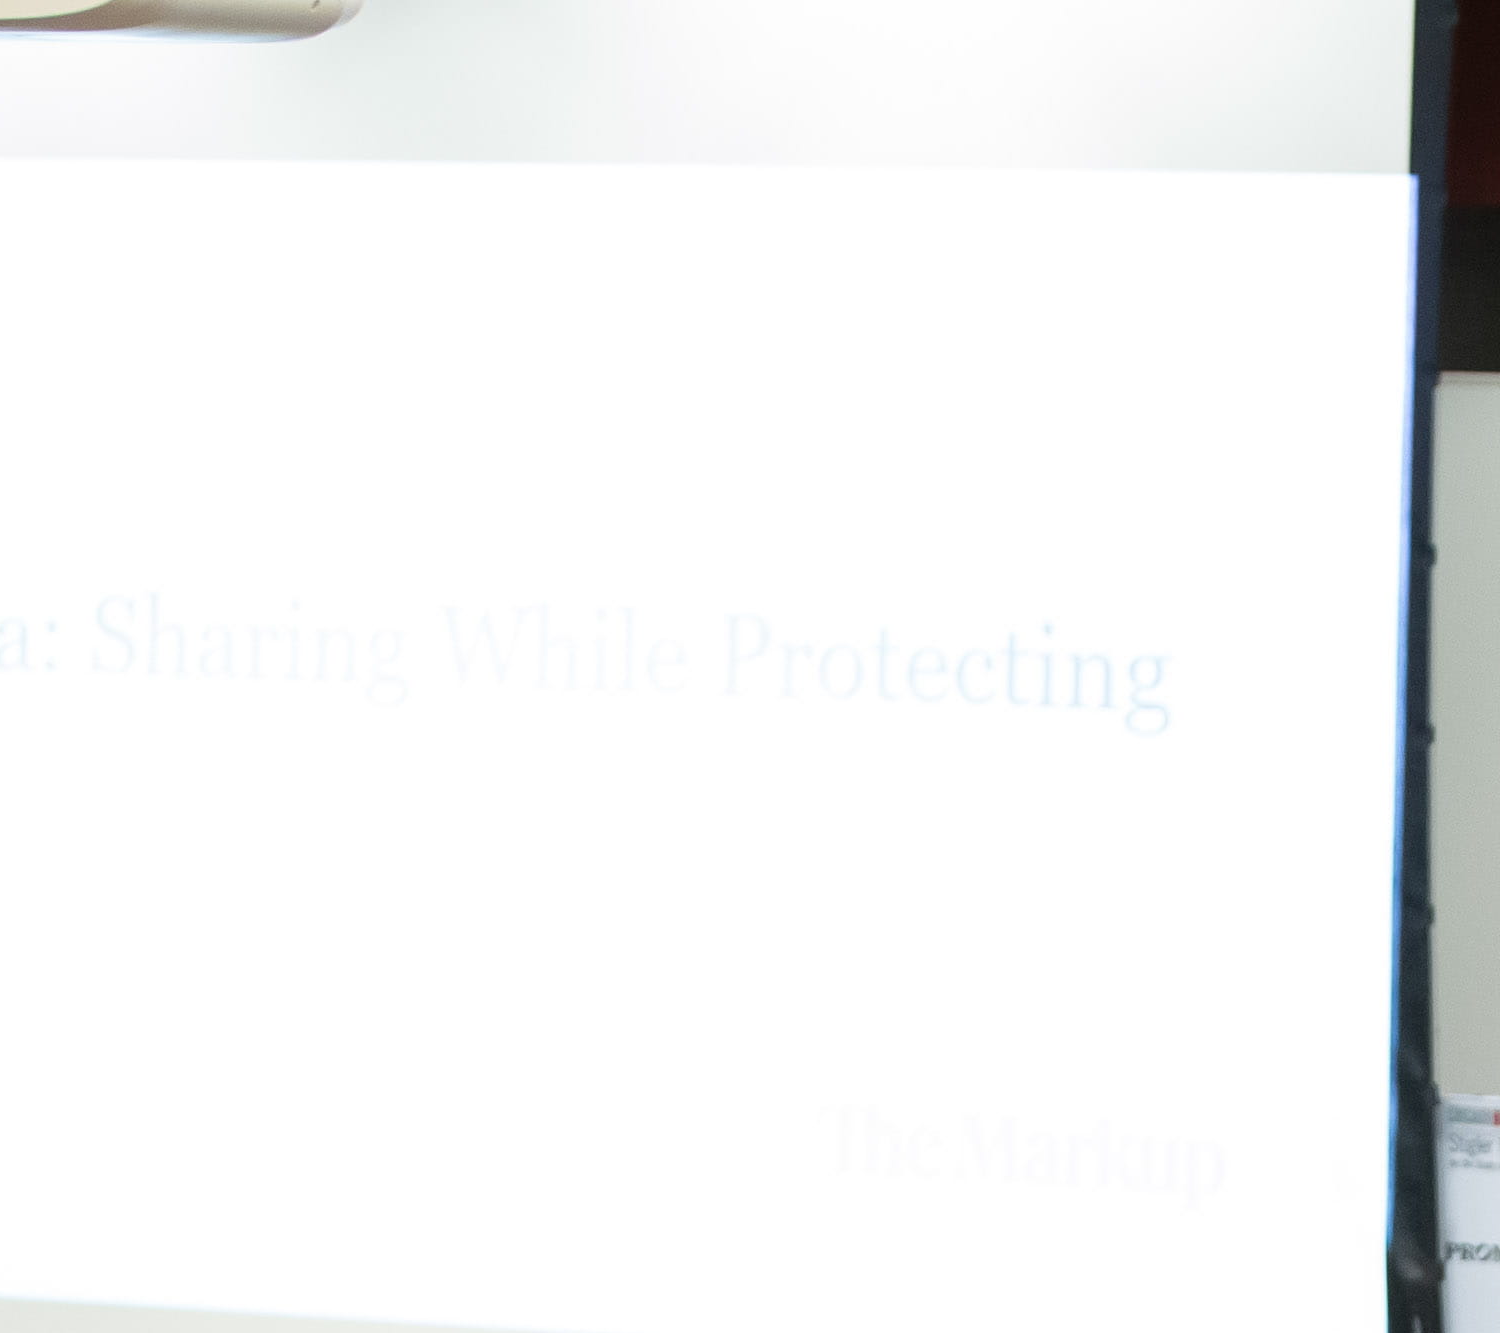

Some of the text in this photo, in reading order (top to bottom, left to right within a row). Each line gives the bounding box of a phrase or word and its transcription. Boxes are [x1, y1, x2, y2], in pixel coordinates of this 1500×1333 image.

[91, 593, 411, 709] Sharing
[439, 602, 691, 699] While
[720, 610, 1174, 739] Protecting
